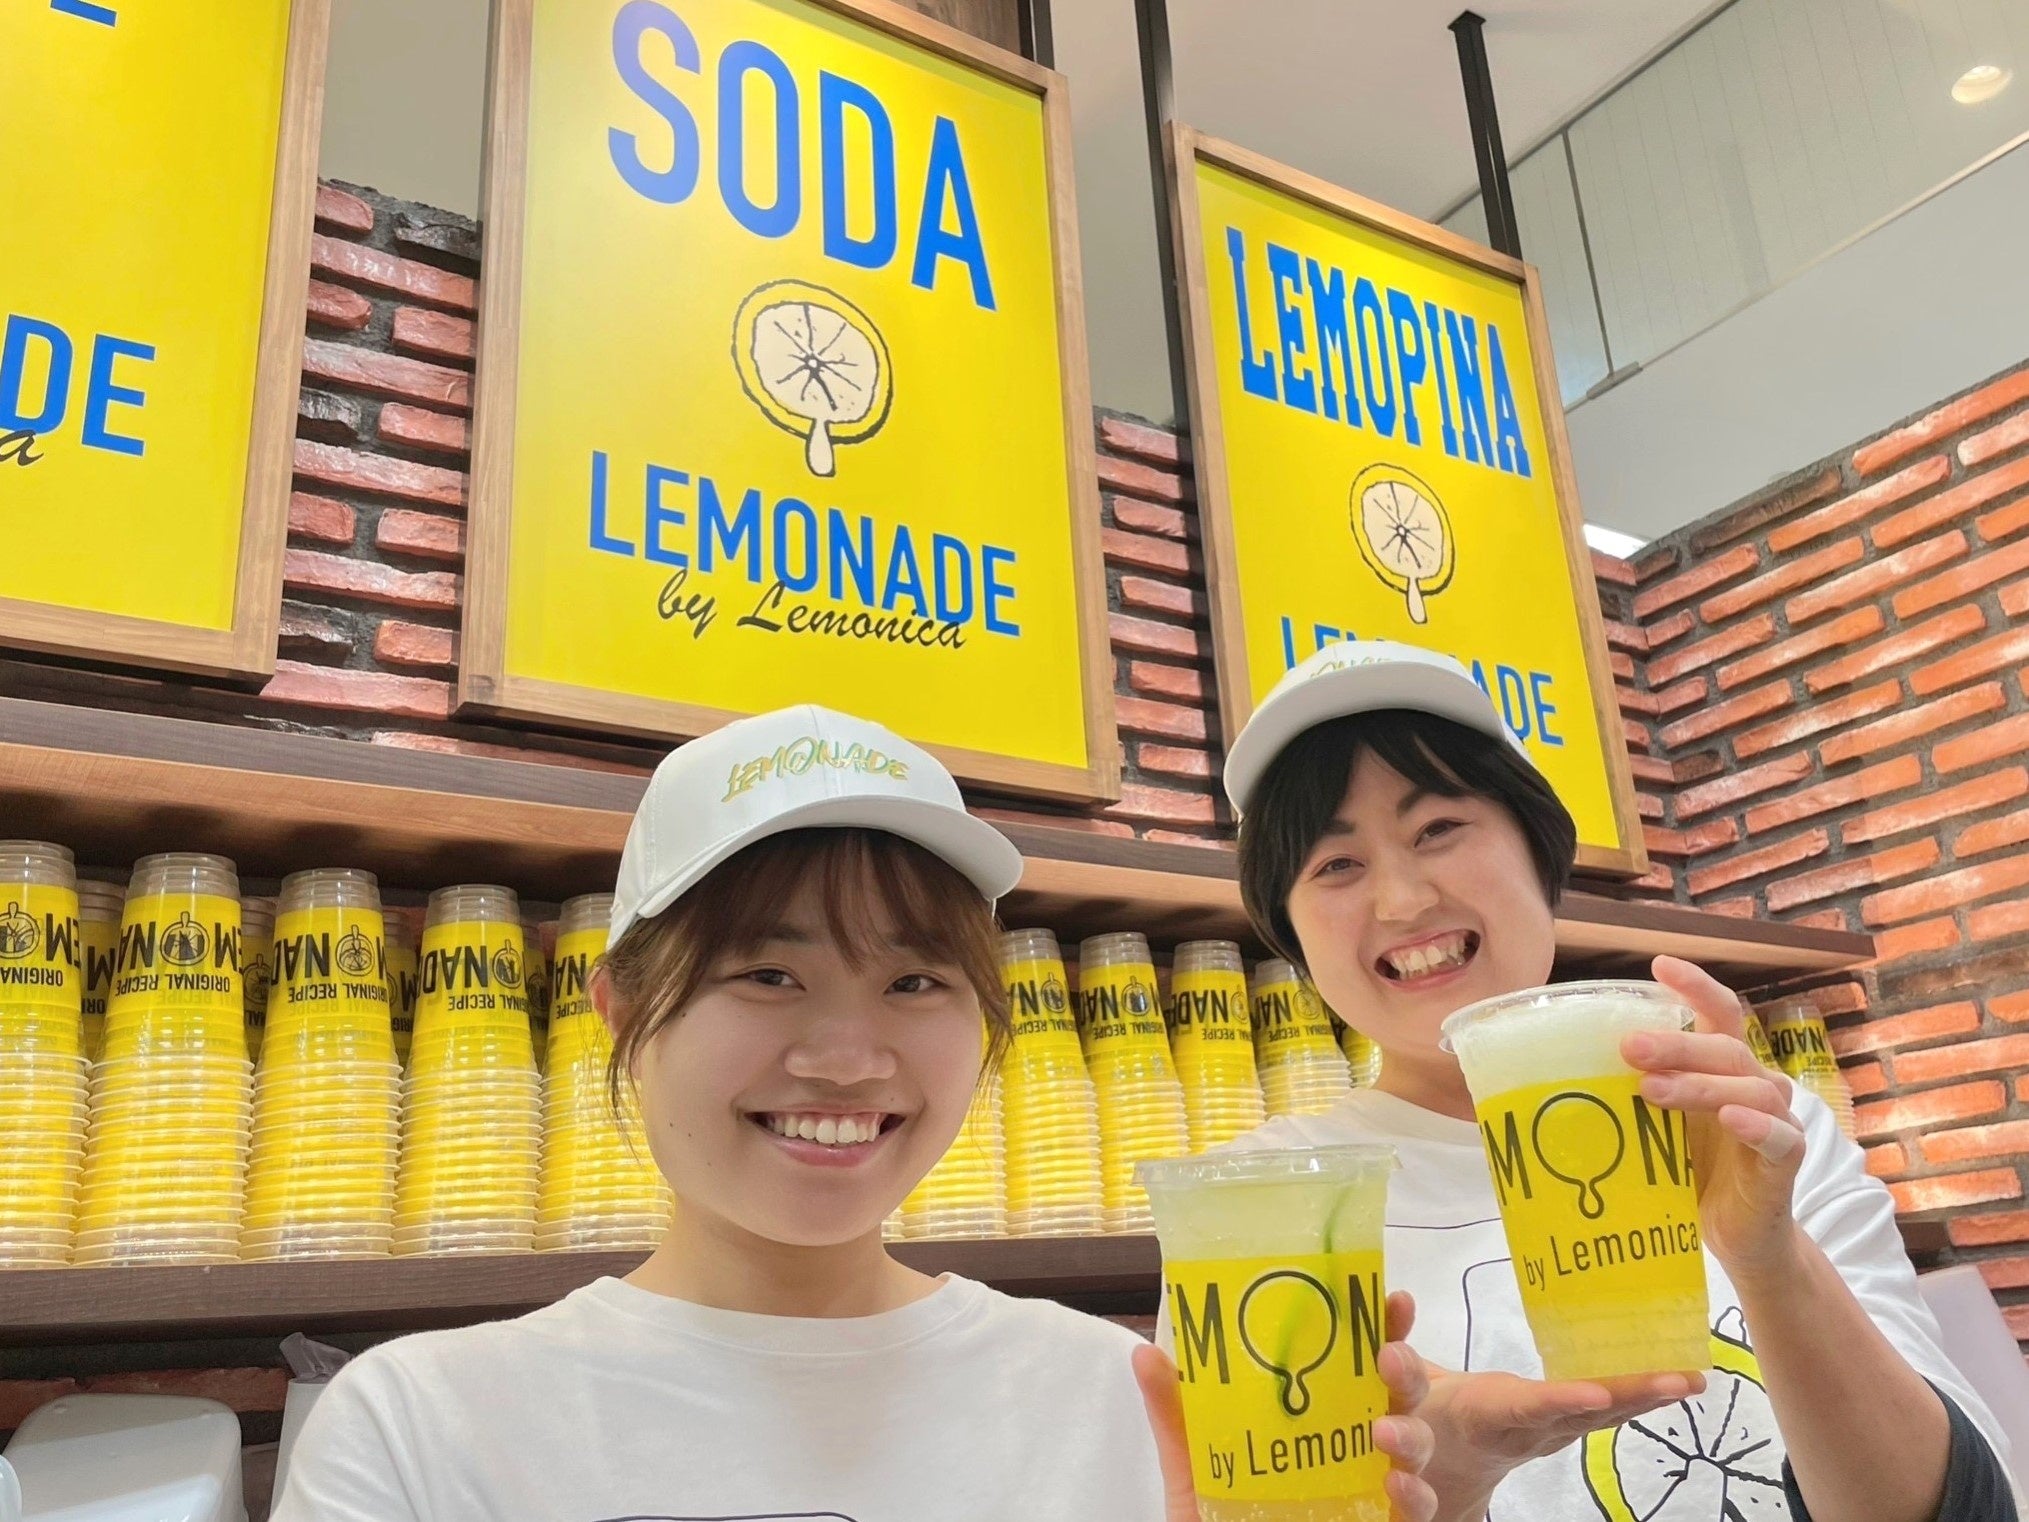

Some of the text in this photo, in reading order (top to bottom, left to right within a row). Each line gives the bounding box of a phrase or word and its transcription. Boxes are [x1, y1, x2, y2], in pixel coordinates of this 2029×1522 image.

[608, 0, 996, 312] SODA
[1225, 226, 1532, 478] LEMOPINA
[589, 450, 1021, 637] LEMONADE
[657, 569, 967, 650] by Lemonica
[721, 735, 909, 803] LEMONADE
[115, 973, 231, 997] ORIGINAL RECIPE
[288, 983, 337, 1003] RECIPE
[448, 994, 495, 1012] RECIPE
[1524, 1213, 1699, 1292] by Lemonica
[1208, 1407, 1375, 1489] by Lemoni
